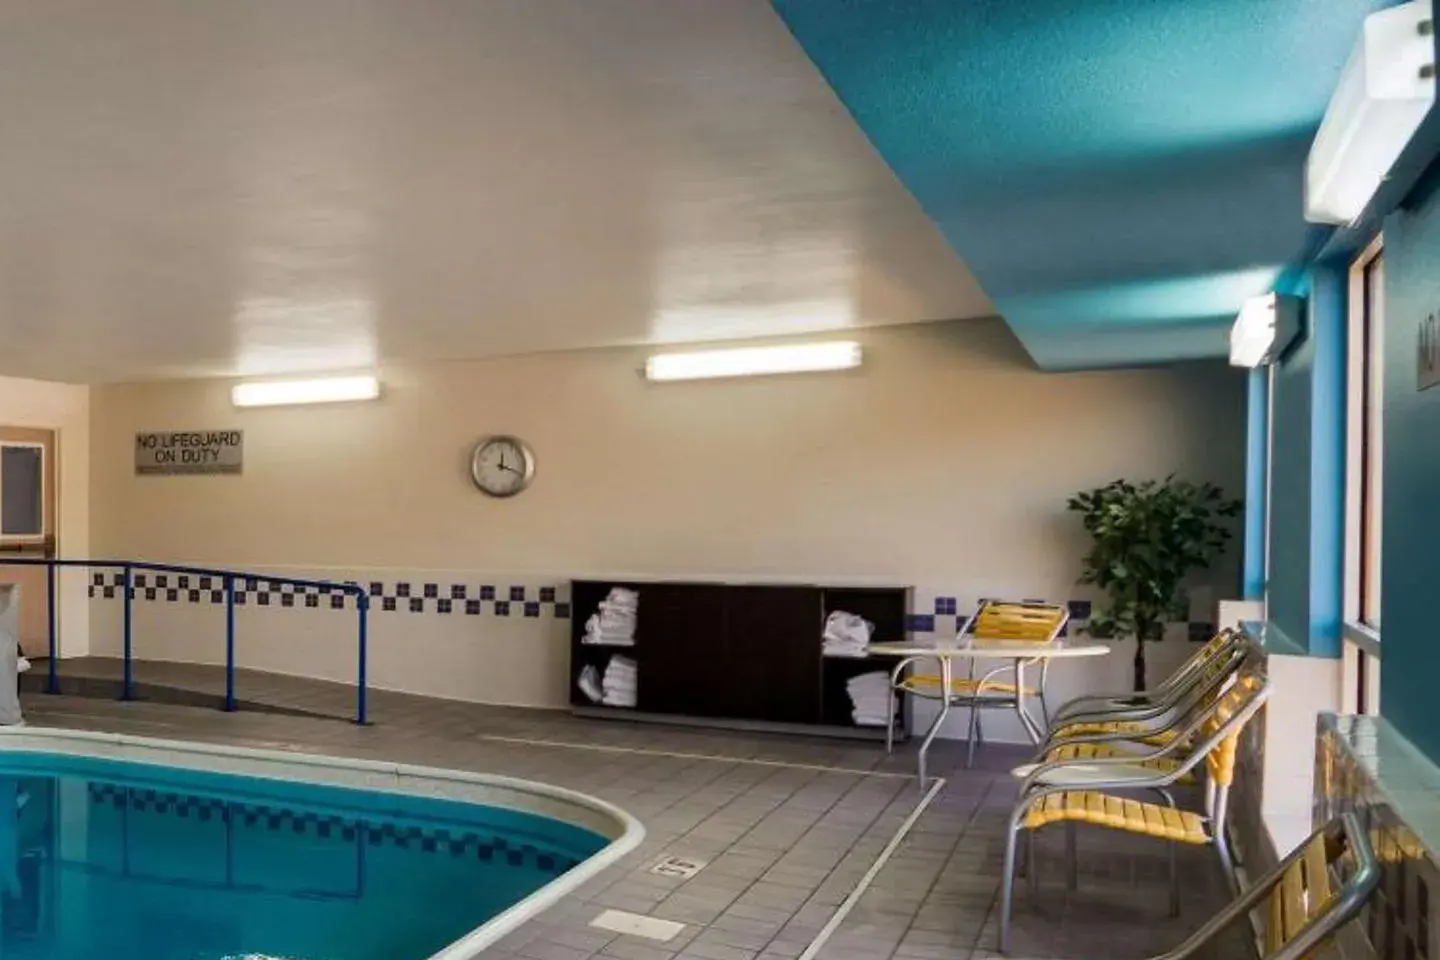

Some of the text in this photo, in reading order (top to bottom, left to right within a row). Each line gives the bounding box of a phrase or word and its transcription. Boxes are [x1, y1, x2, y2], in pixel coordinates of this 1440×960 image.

[137, 431, 241, 449] NO LIFEGUARD
[155, 448, 220, 463] ON DUTY
